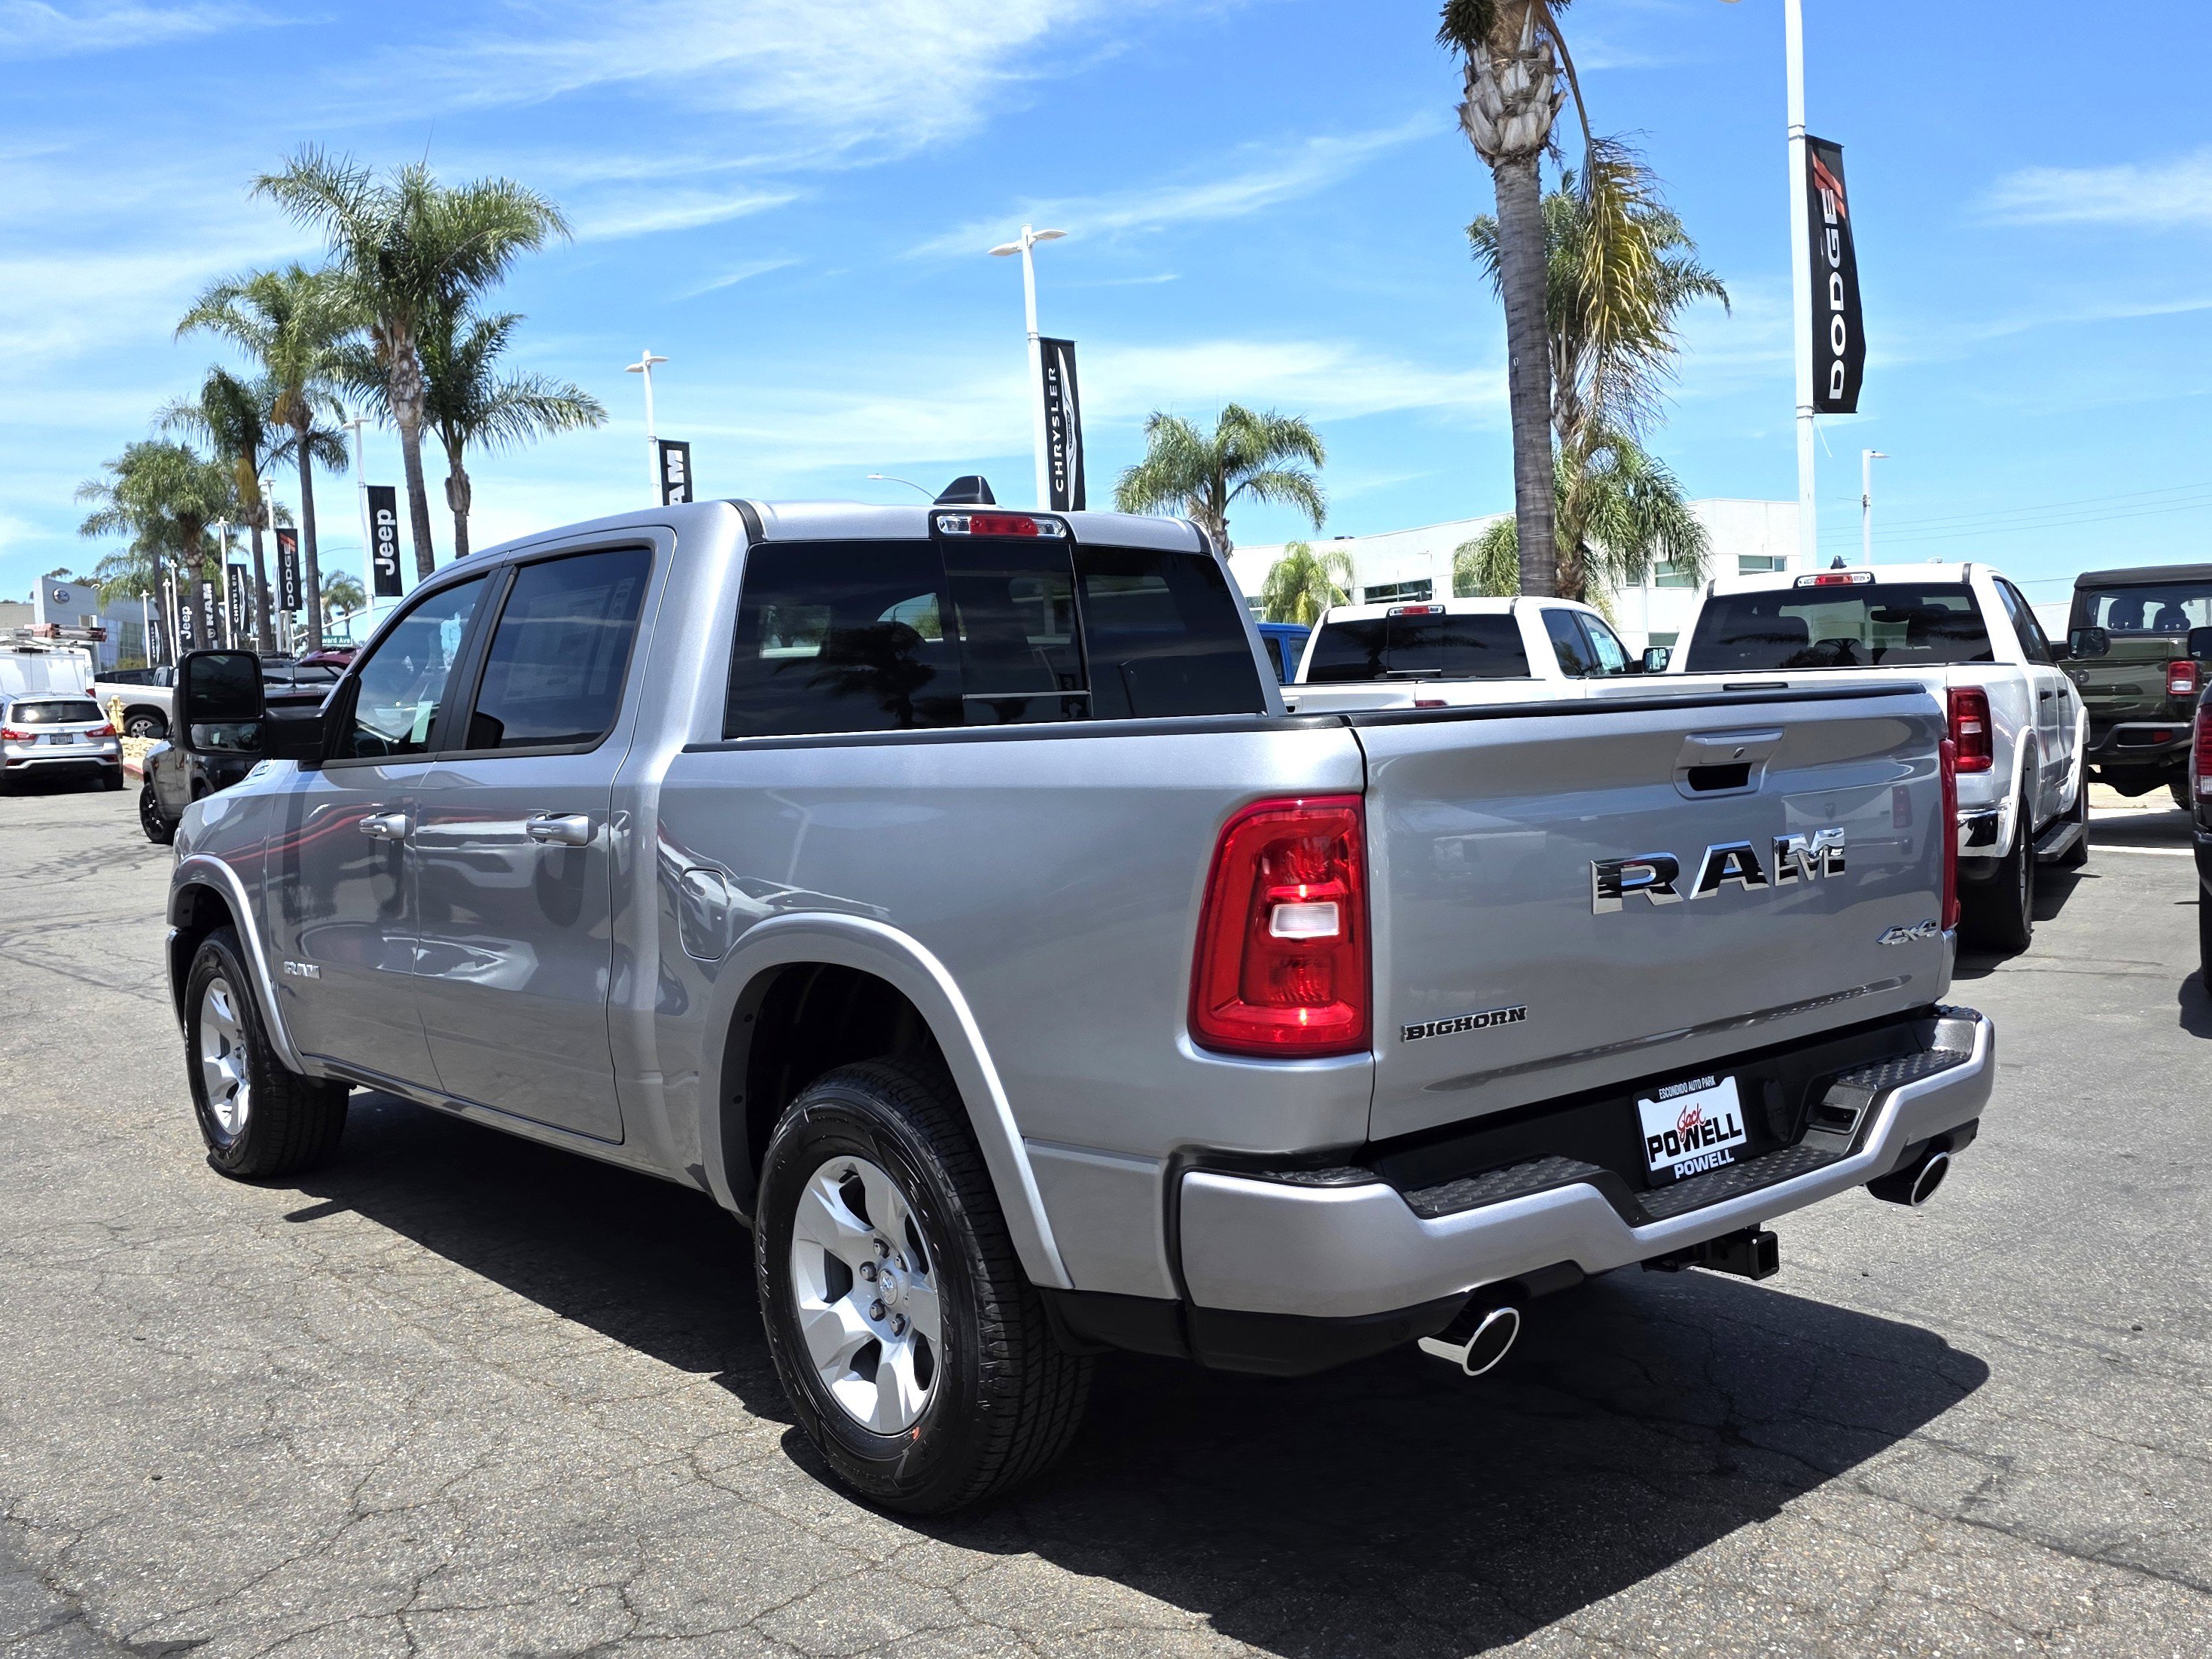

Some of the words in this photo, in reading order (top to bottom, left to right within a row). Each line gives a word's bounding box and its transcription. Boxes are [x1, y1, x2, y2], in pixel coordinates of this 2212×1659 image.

[1820, 188, 1846, 400] DODGE
[1048, 367, 1064, 493] CHRYSLER
[666, 450, 685, 506] AM
[375, 508, 396, 576] Jeep
[283, 542, 294, 608] DODGE
[181, 605, 192, 640] Jeep
[203, 583, 214, 626] RAM
[1590, 827, 1845, 915] RAM
[284, 961, 321, 979] RAM
[1402, 1005, 1528, 1043] BIGHORN
[1659, 1081, 1688, 1099] ESCONDIDO
[1688, 1078, 1702, 1092] AUTO
[1701, 1075, 1716, 1088] PARK
[1647, 1112, 1743, 1163] POWELL
[1677, 1102, 1706, 1142] Jack
[1674, 1148, 1735, 1179] POWELL
